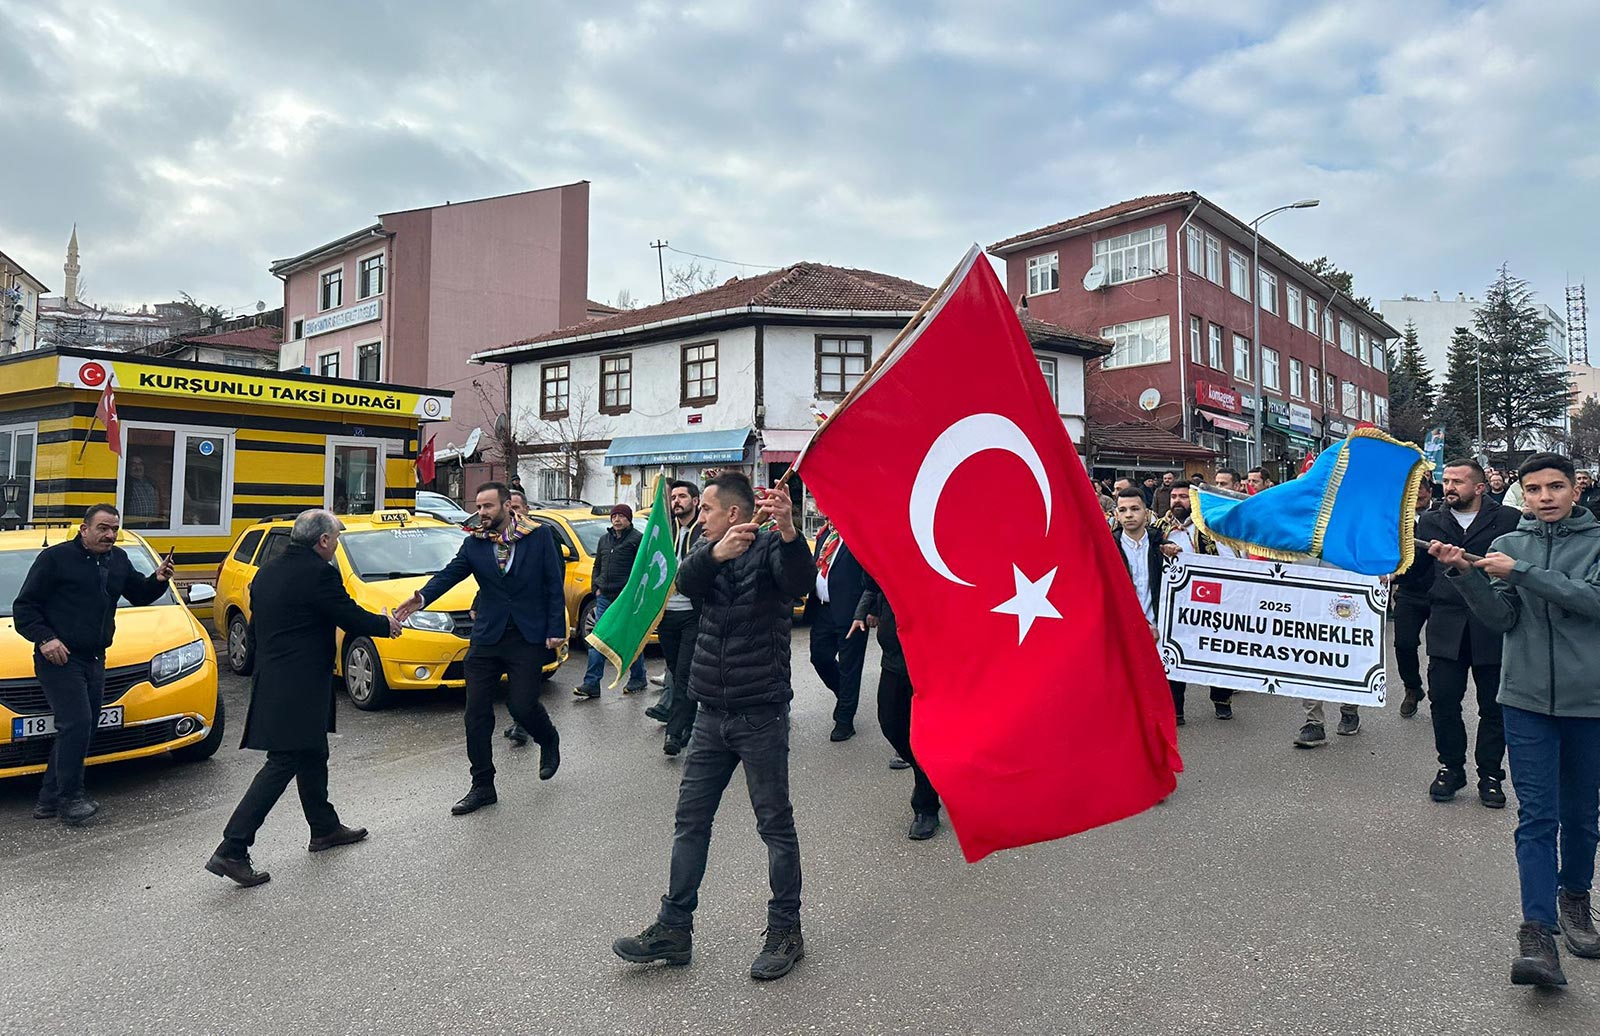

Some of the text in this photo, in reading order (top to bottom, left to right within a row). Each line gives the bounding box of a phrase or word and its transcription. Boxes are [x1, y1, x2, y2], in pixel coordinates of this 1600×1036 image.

[139, 373, 401, 410] KURŞUNLU TAKSİ DURAĞI
[1259, 600, 1292, 613] 2025
[1177, 606, 1374, 647] KURŞUNLU DERNEKLER
[1198, 636, 1349, 668] FEDERASYONU
[27, 719, 46, 734] 18
[99, 710, 119, 725] 23
